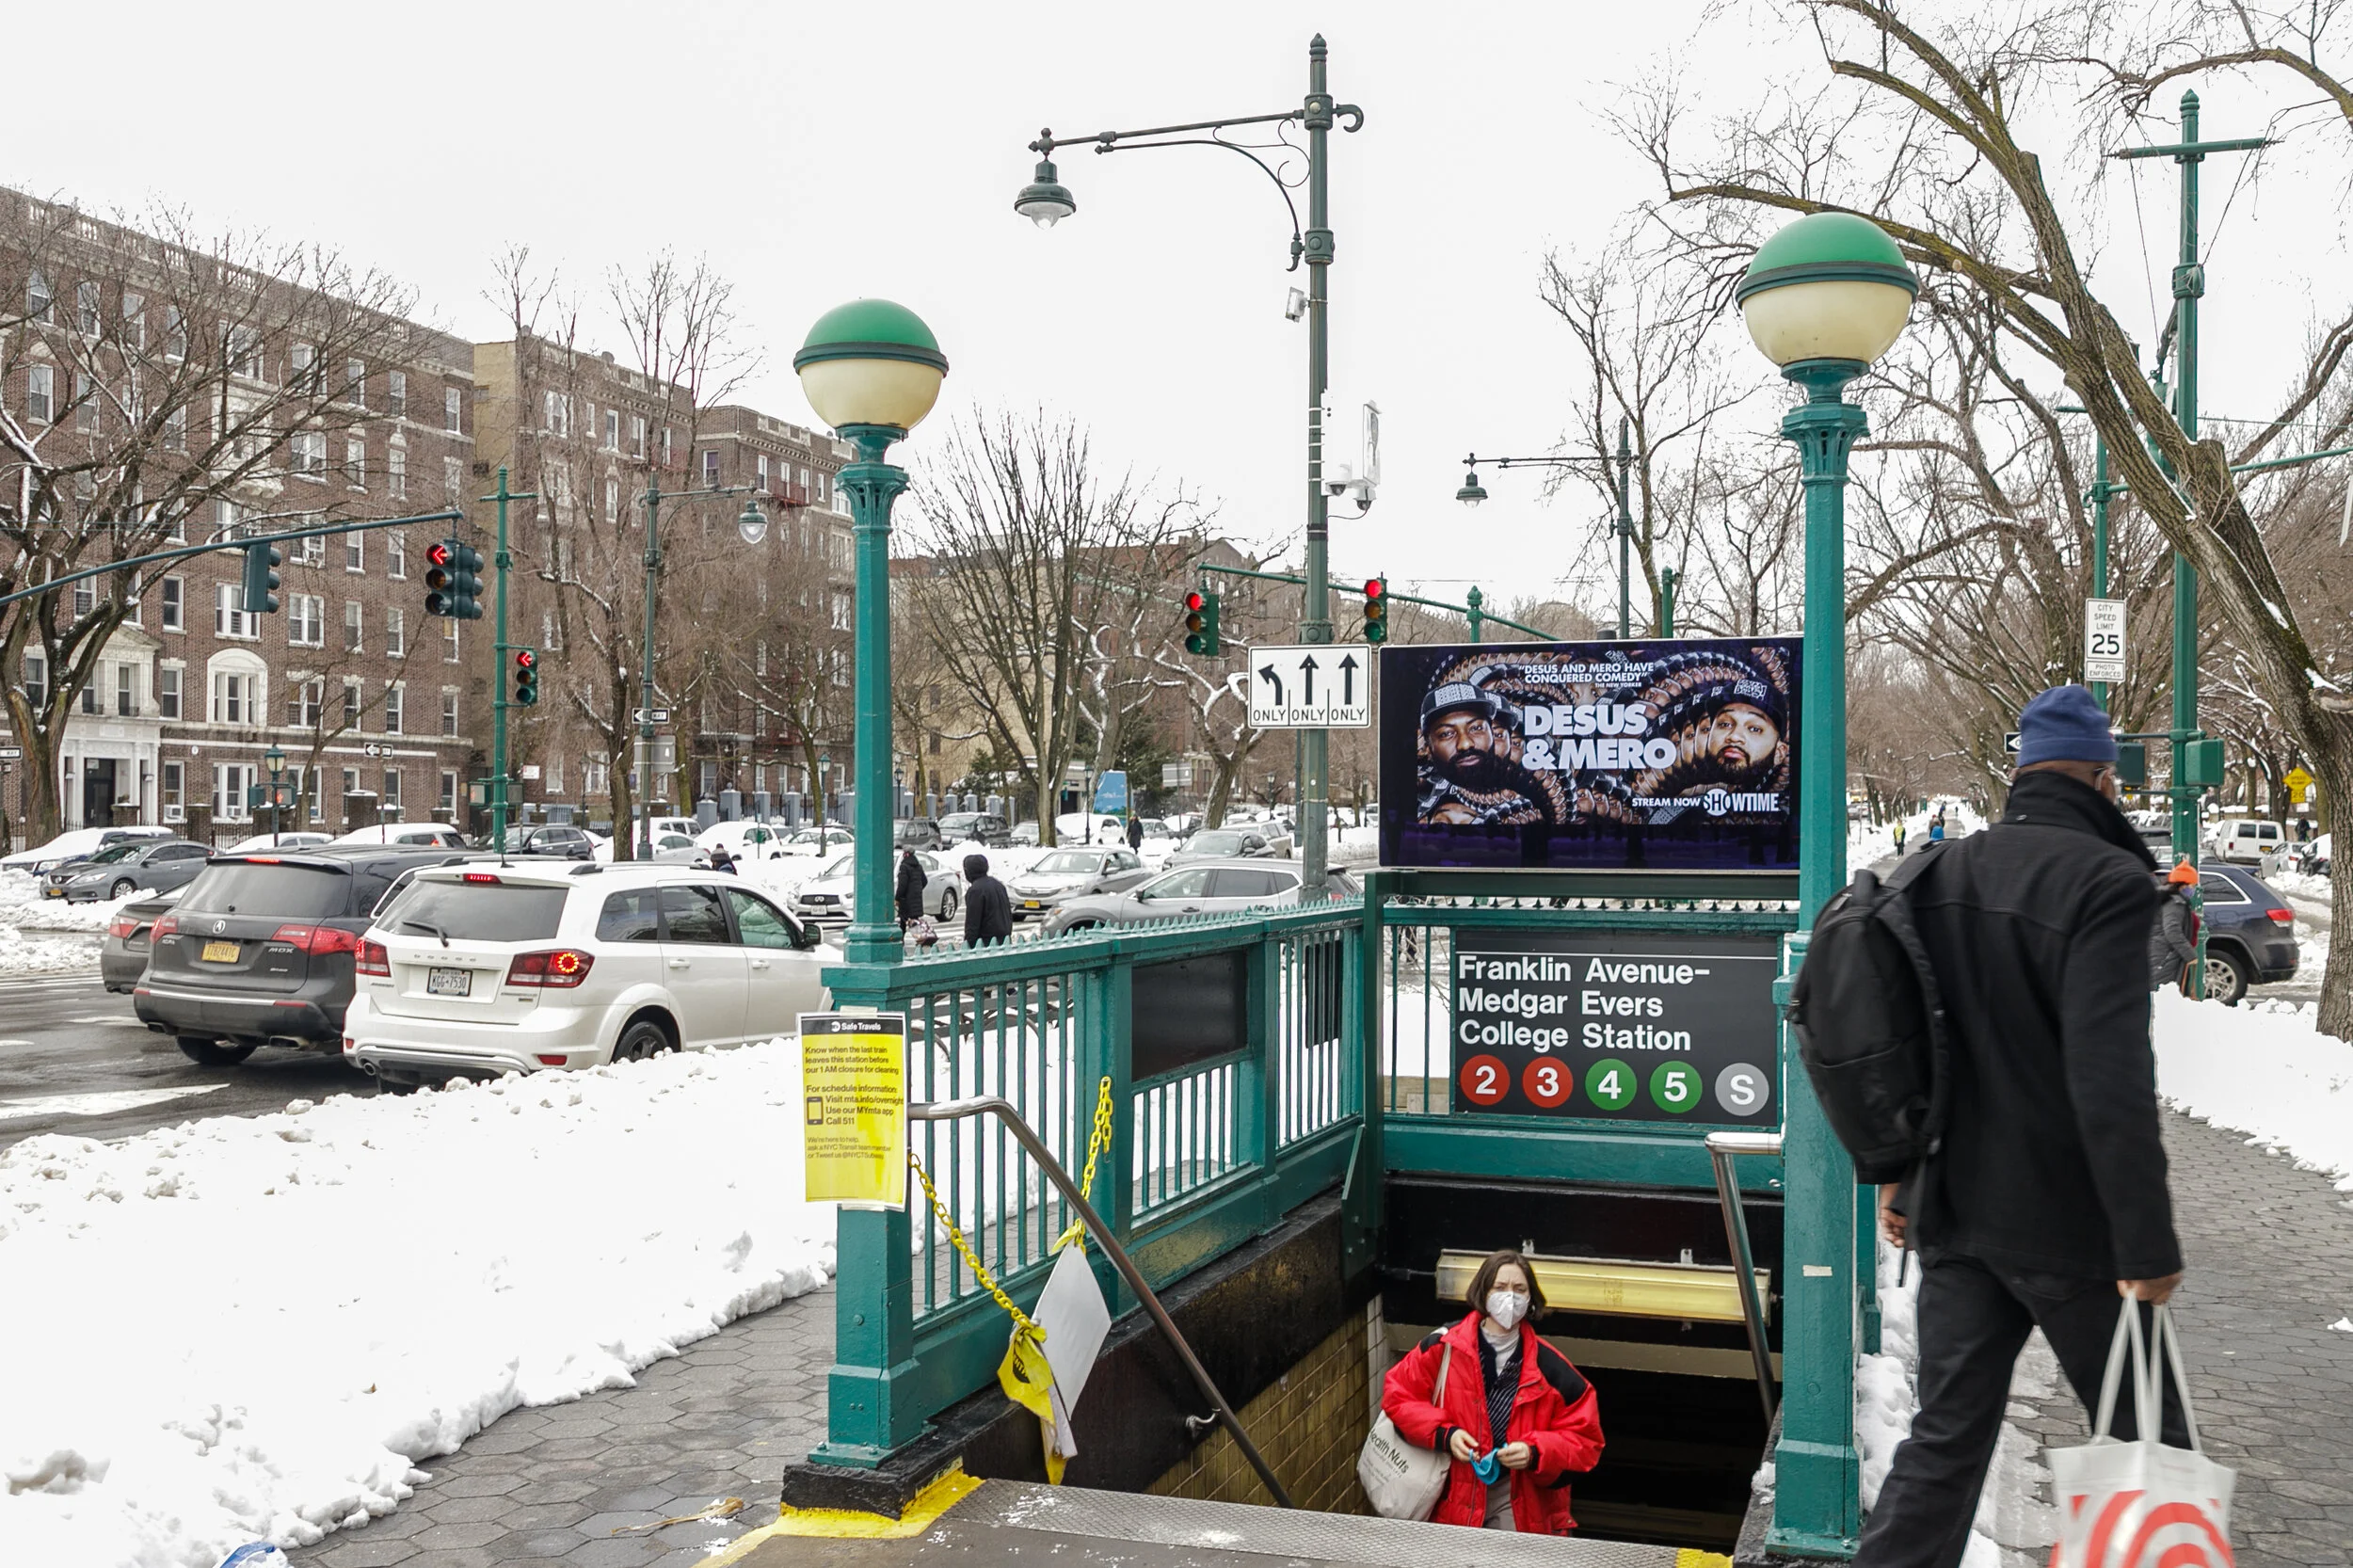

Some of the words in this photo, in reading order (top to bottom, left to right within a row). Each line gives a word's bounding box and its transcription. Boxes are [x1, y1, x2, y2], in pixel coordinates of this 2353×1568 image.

[2092, 633, 2120, 654] 25
[1525, 673, 1593, 683] CONQUERED
[1561, 664, 1585, 673] AND
[1589, 664, 1621, 672] MERO
[1625, 663, 1654, 672] HAVE
[1254, 710, 1286, 721] ONLY
[1291, 710, 1325, 721] ONLY
[1331, 709, 1365, 720] ONLY
[1525, 704, 1648, 736] DESUS
[1632, 798, 1671, 807] STREAM
[1704, 789, 1780, 816] SHOWTIME
[1459, 955, 1571, 982] Franklin
[1585, 958, 1710, 984] Avenue-
[1459, 987, 1567, 1018] Medgar
[1581, 991, 1663, 1017] Evers
[841, 1022, 857, 1031] Safe
[858, 1022, 881, 1031] Travels
[1460, 1020, 1568, 1053] College
[1583, 1022, 1691, 1051] Station
[874, 1066, 899, 1075] cleaning
[1476, 1065, 1497, 1096] 2
[1537, 1066, 1560, 1097] 3
[1598, 1070, 1622, 1099] 4
[1664, 1072, 1687, 1102] 5
[1730, 1075, 1755, 1105] S
[1387, 1448, 1410, 1474] Nuts
